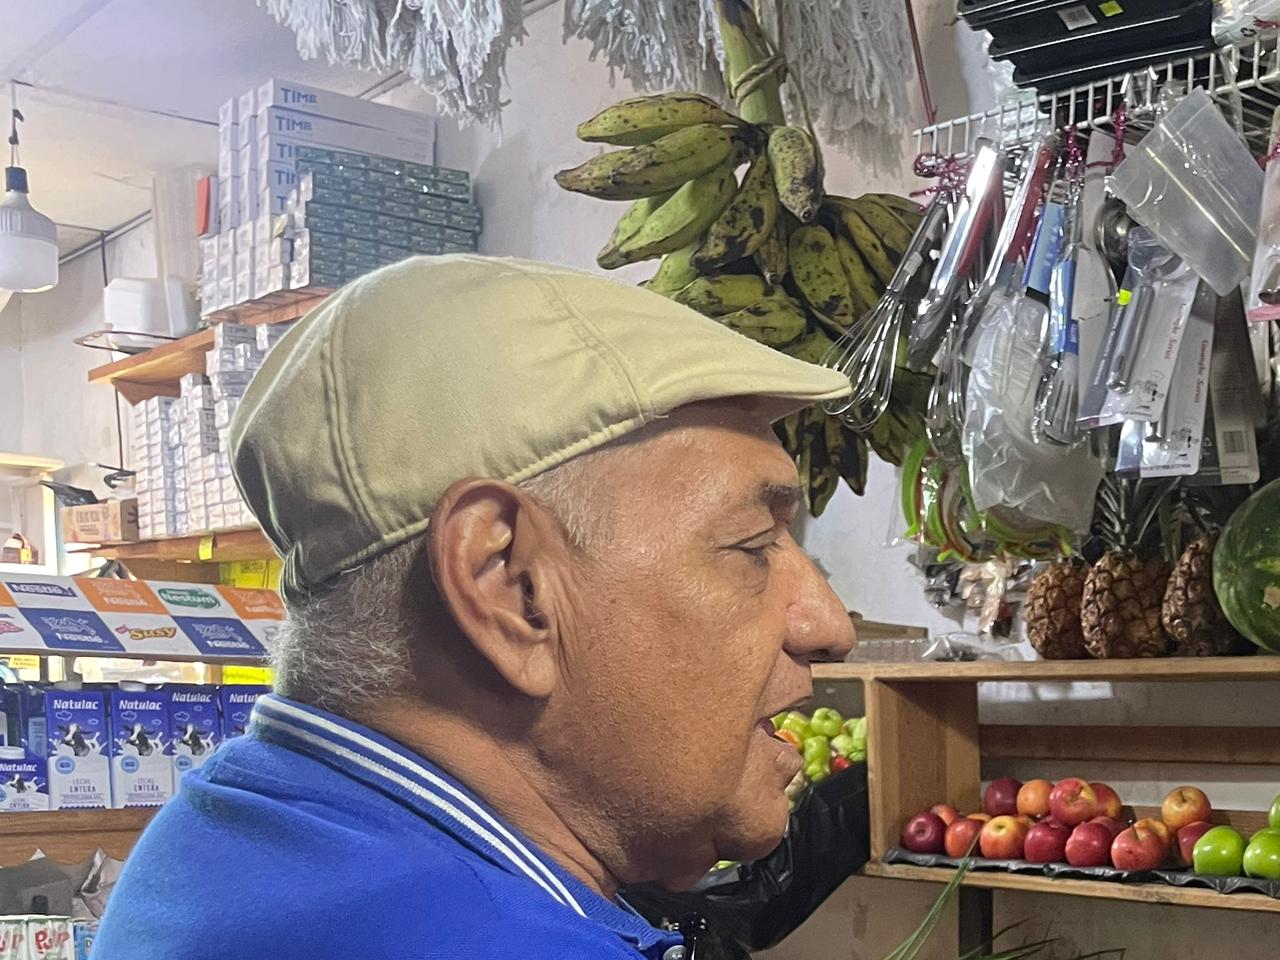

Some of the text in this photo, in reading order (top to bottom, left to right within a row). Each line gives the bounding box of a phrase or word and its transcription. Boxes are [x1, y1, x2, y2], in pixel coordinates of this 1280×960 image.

[281, 87, 317, 104] TIME
[275, 115, 313, 132] TIME
[128, 627, 177, 641] Susy
[172, 692, 212, 703] Natulac
[53, 699, 99, 710] Natulac
[119, 700, 162, 711] Natulac
